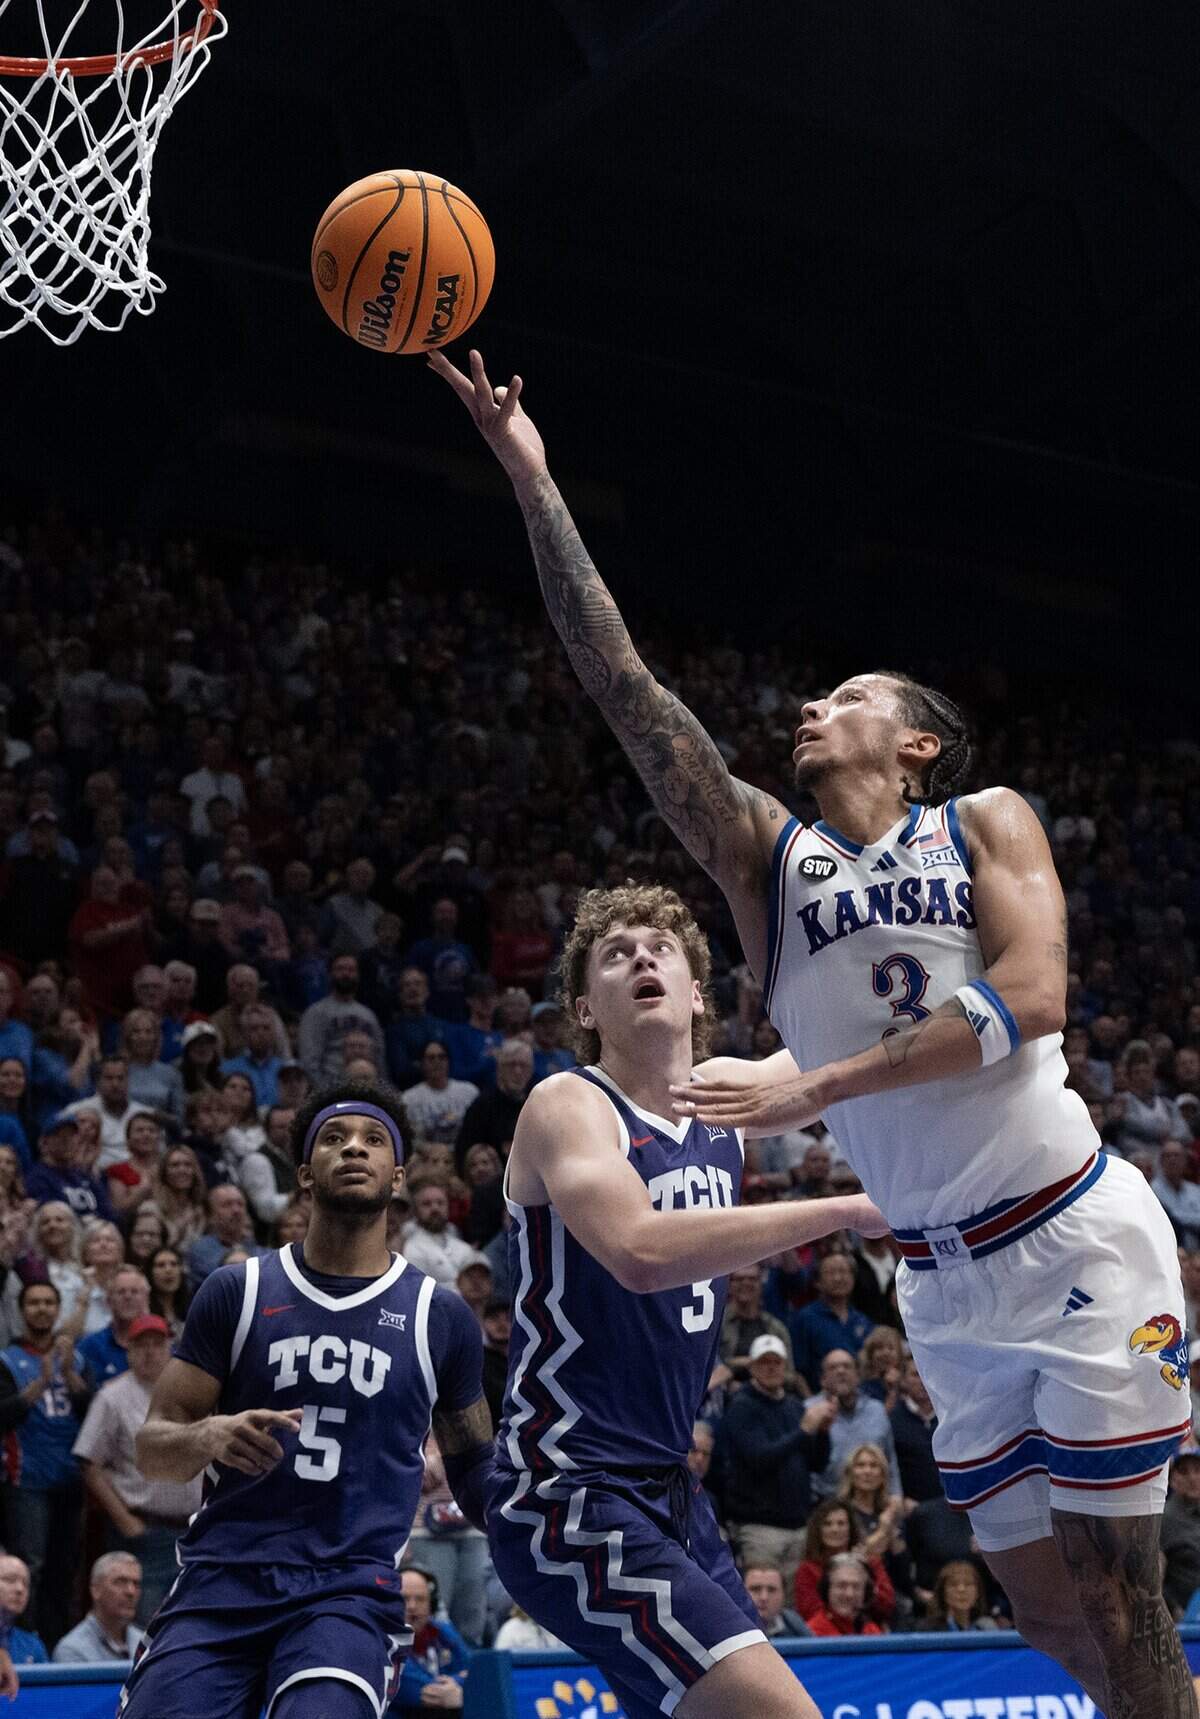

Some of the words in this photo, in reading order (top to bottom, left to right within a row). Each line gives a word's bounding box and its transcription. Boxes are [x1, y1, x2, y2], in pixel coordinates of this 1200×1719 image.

[357, 250, 411, 347] Wilson
[421, 274, 462, 345] NCAA
[802, 858, 834, 877] SW
[796, 876, 978, 956] KANSAS
[872, 953, 931, 1040] 3
[649, 1165, 734, 1212] TCU
[935, 1238, 958, 1256] KU
[681, 1278, 715, 1334] 3
[267, 1335, 392, 1398] TCU
[1175, 1345, 1188, 1365] KU
[294, 1404, 347, 1482] 5
